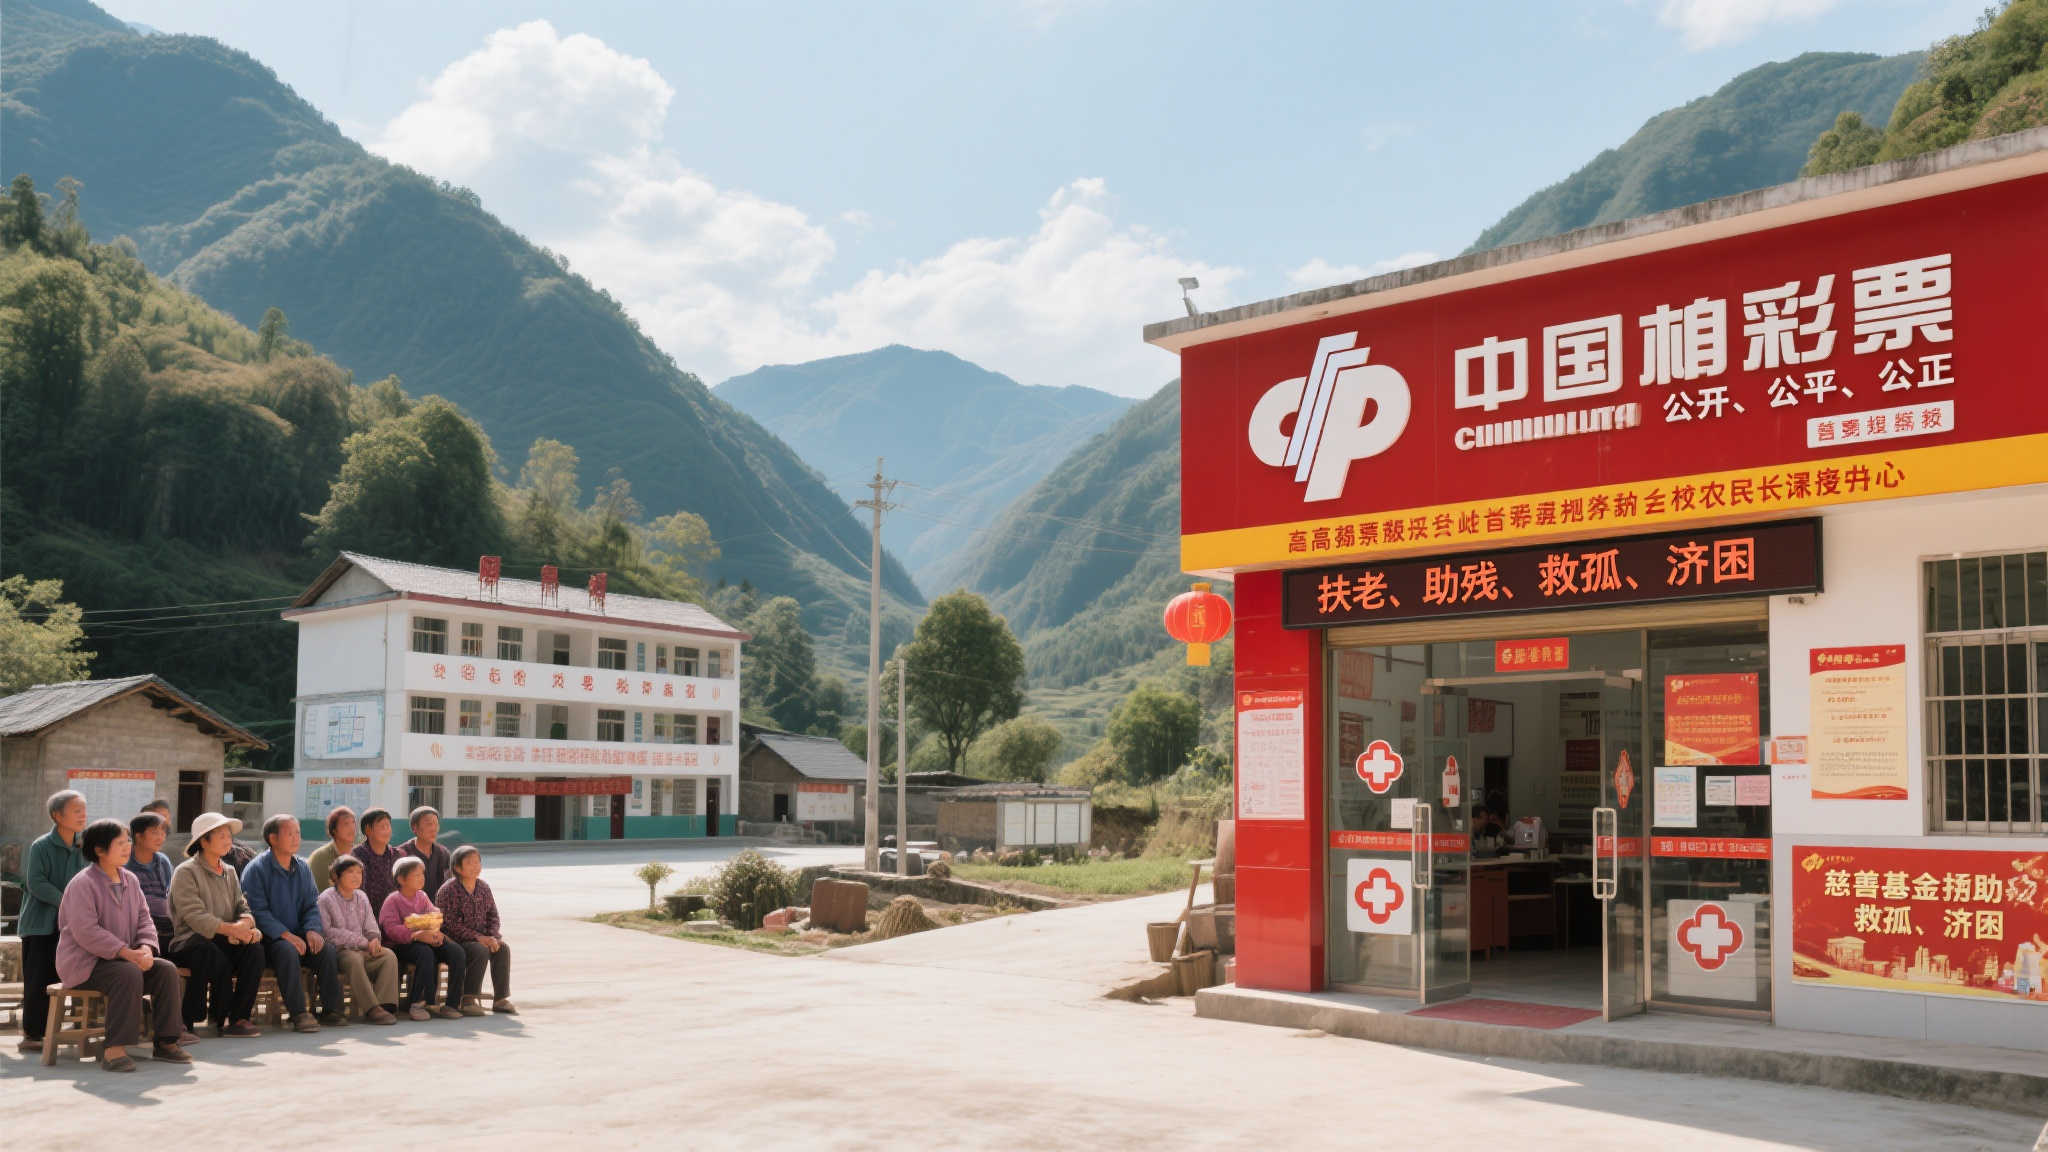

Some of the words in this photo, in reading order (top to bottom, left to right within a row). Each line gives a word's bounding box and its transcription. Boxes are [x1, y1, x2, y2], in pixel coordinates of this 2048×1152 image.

[1663, 352, 1955, 423] 公开、公平、公正
[1317, 537, 1756, 614] 扶老、助残、救孤、济困
[1854, 904, 2004, 941] 救孤、济困
